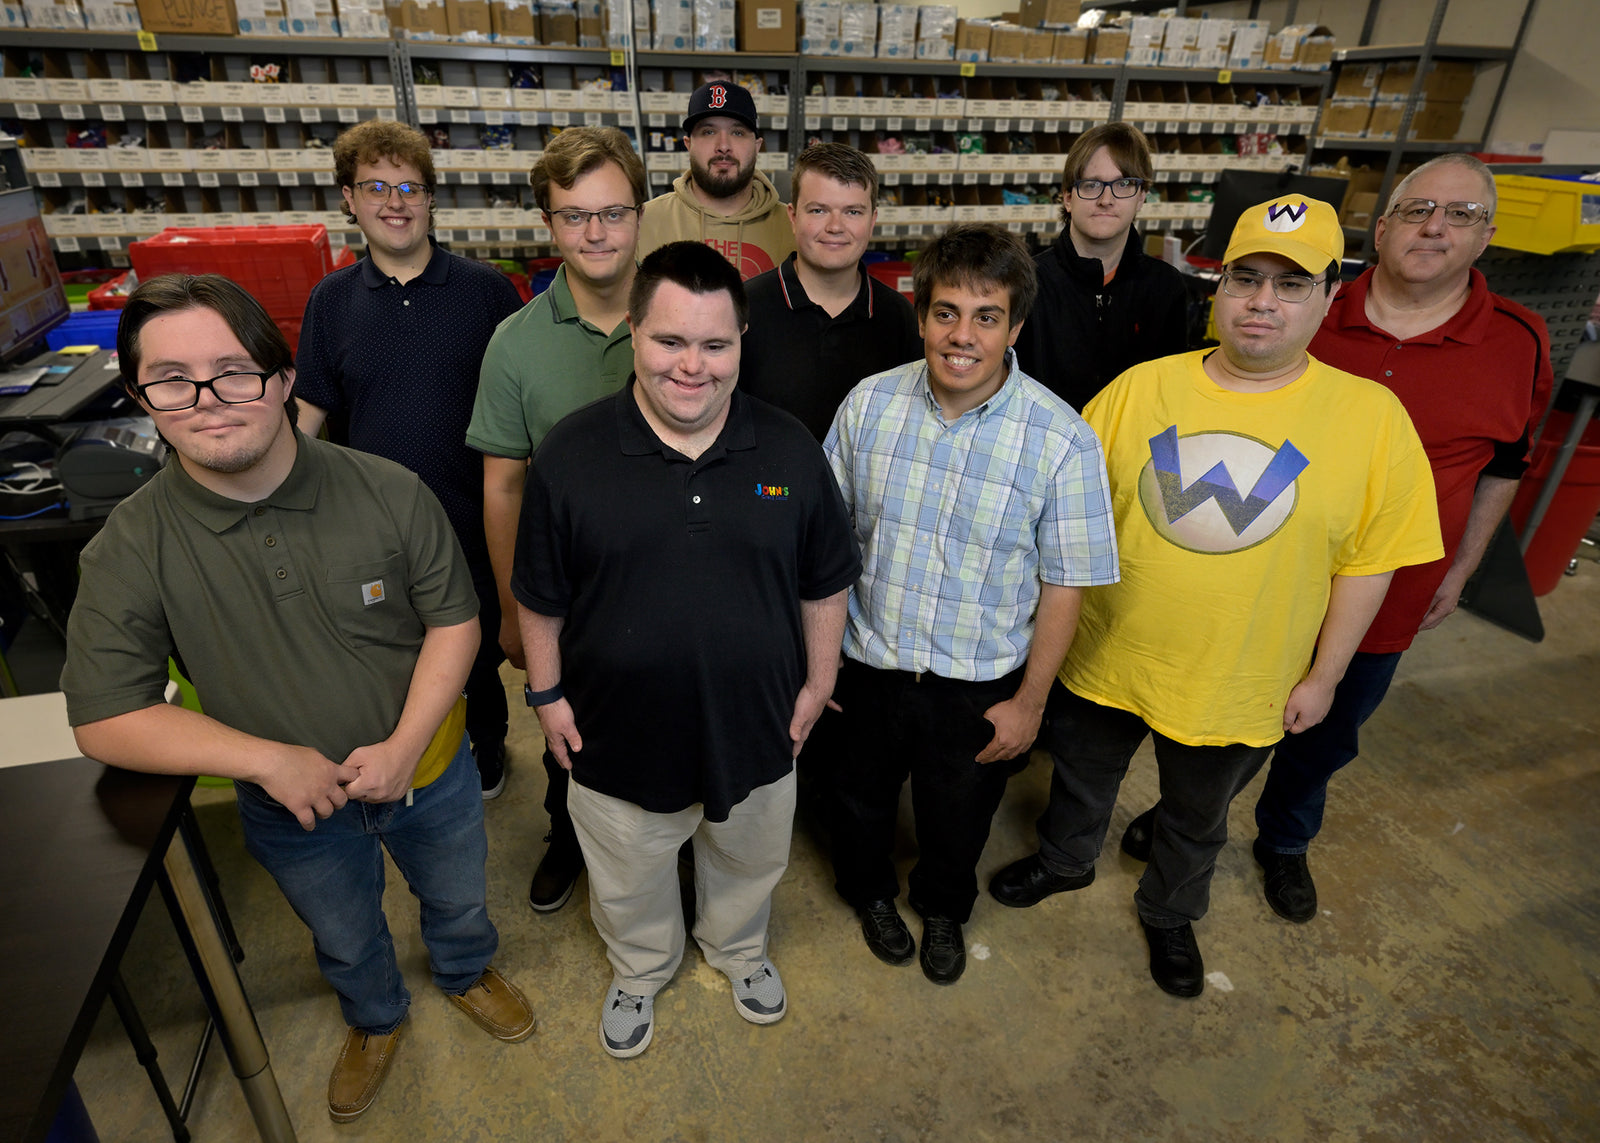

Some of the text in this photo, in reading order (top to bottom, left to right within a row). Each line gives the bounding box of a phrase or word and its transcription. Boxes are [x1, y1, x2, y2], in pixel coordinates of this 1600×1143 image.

[708, 84, 727, 108] B
[1268, 201, 1308, 222] W
[1148, 424, 1309, 536] W
